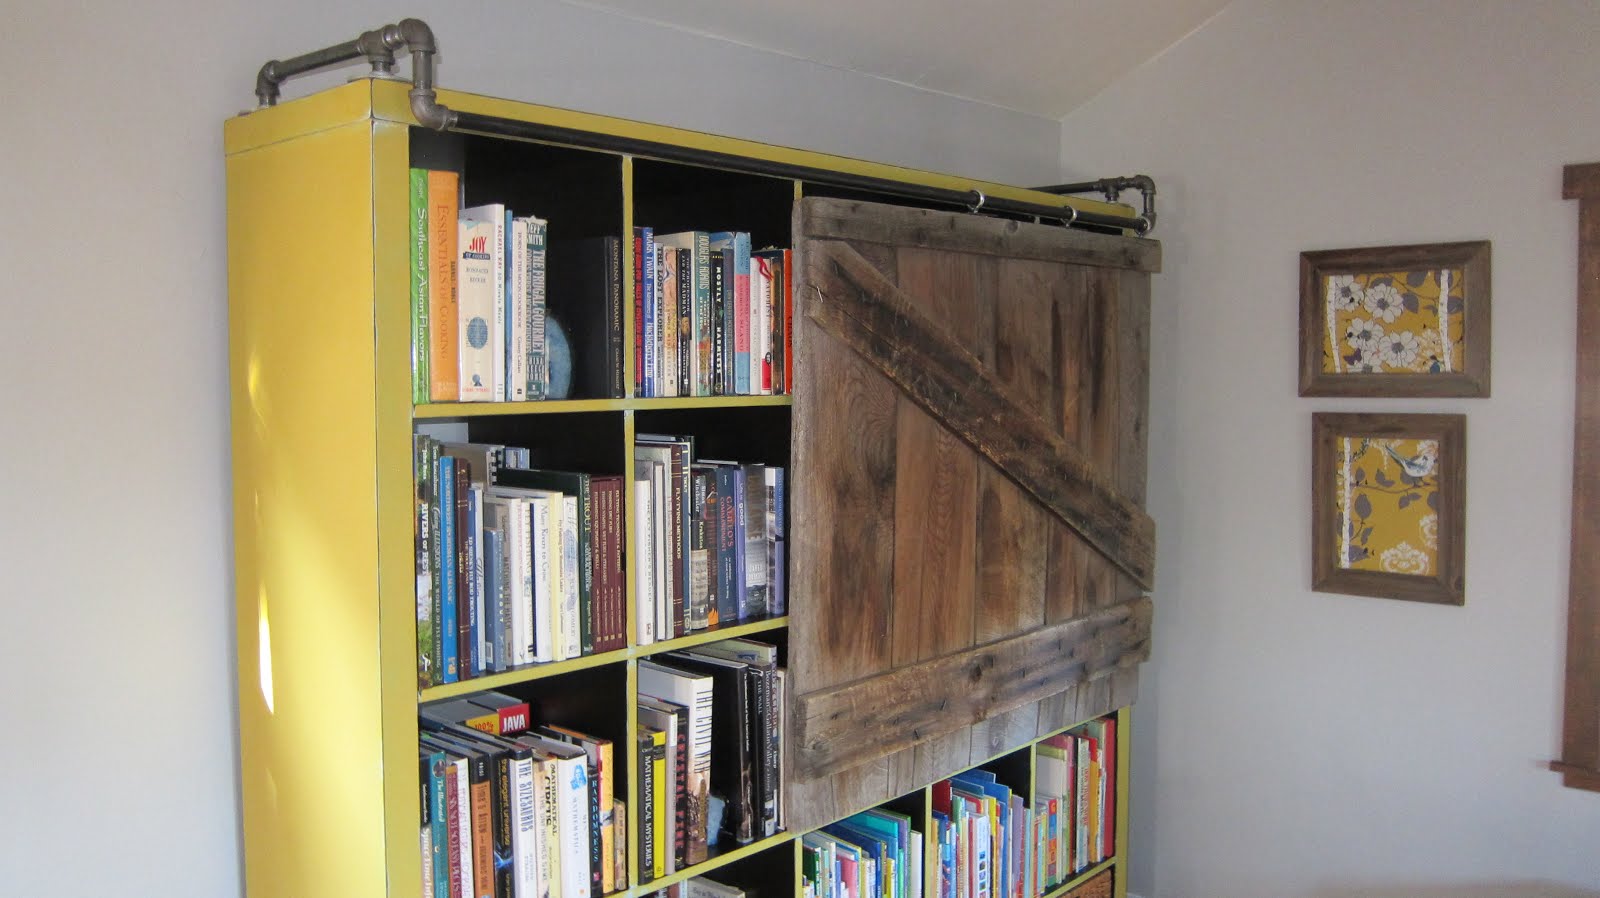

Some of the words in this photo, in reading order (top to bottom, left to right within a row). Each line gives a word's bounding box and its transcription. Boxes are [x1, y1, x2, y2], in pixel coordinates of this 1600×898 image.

[417, 207, 427, 272] Southeast
[437, 204, 448, 284] ESSENTIALS
[469, 236, 487, 253] JOY
[698, 235, 710, 265] DOUGLAS
[533, 250, 545, 270] THE
[418, 273, 427, 312] Asian
[533, 270, 545, 306] FRUGAL
[698, 266, 710, 290] ADAMS
[418, 314, 428, 362] Flavors
[440, 305, 448, 360] COOKING
[532, 308, 545, 353] GOURMET
[645, 322, 654, 360] Huckleberry
[421, 503, 429, 539] RIVERS
[540, 505, 548, 526] Many
[726, 496, 734, 547] GALILEO'S
[433, 529, 441, 569] ILLUSIONS
[696, 690, 713, 711] THE
[503, 714, 525, 732] JAVA
[695, 715, 713, 748] CIVIL
[765, 712, 773, 744] Gallatin
[519, 760, 531, 778] THE
[676, 734, 685, 800] CRYSTAL
[695, 750, 712, 774] WAR
[764, 744, 772, 768] Valley
[501, 775, 509, 808] elegant
[519, 781, 533, 833] SIZESAURUS
[591, 780, 599, 862] RANDOMNESS
[675, 810, 685, 849] FIRE
[421, 827, 431, 856] Space
[424, 857, 432, 880] Time
